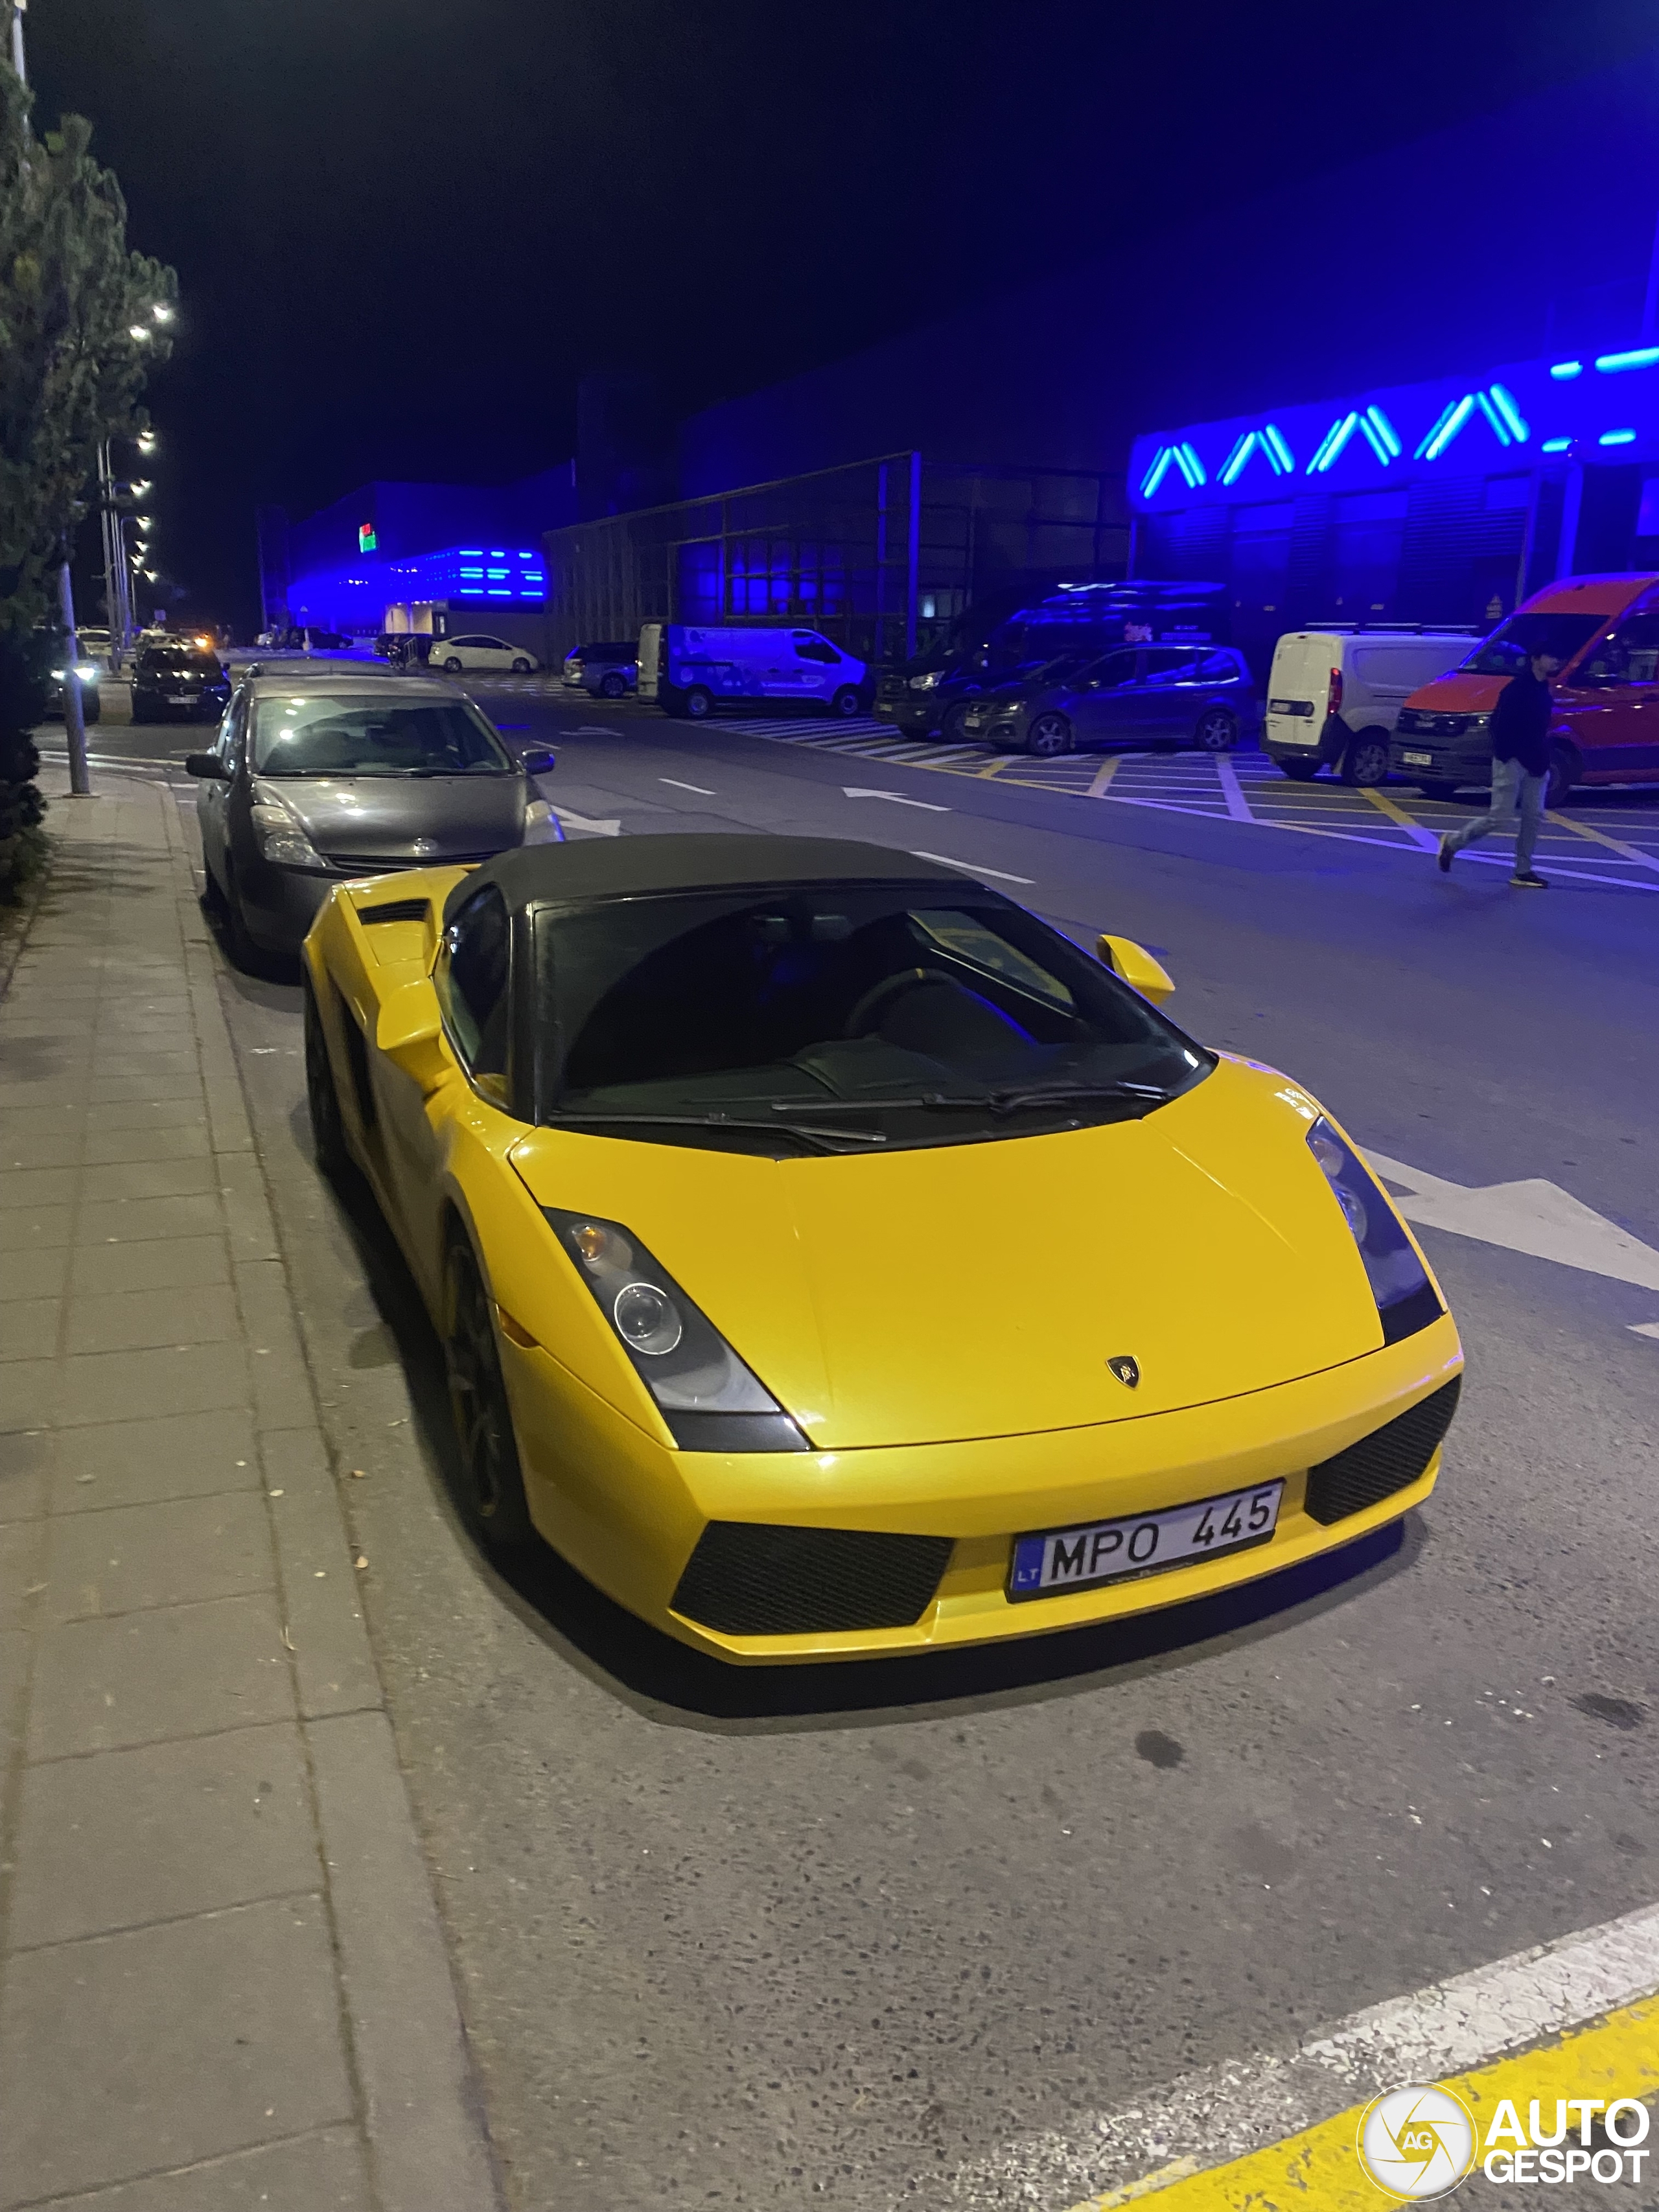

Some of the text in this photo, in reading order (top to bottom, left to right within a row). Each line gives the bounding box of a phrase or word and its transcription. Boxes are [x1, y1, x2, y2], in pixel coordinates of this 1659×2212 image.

[1051, 1523, 1159, 1580] MPO
[1192, 1491, 1273, 1546] 445
[1017, 1568, 1039, 1583] LT
